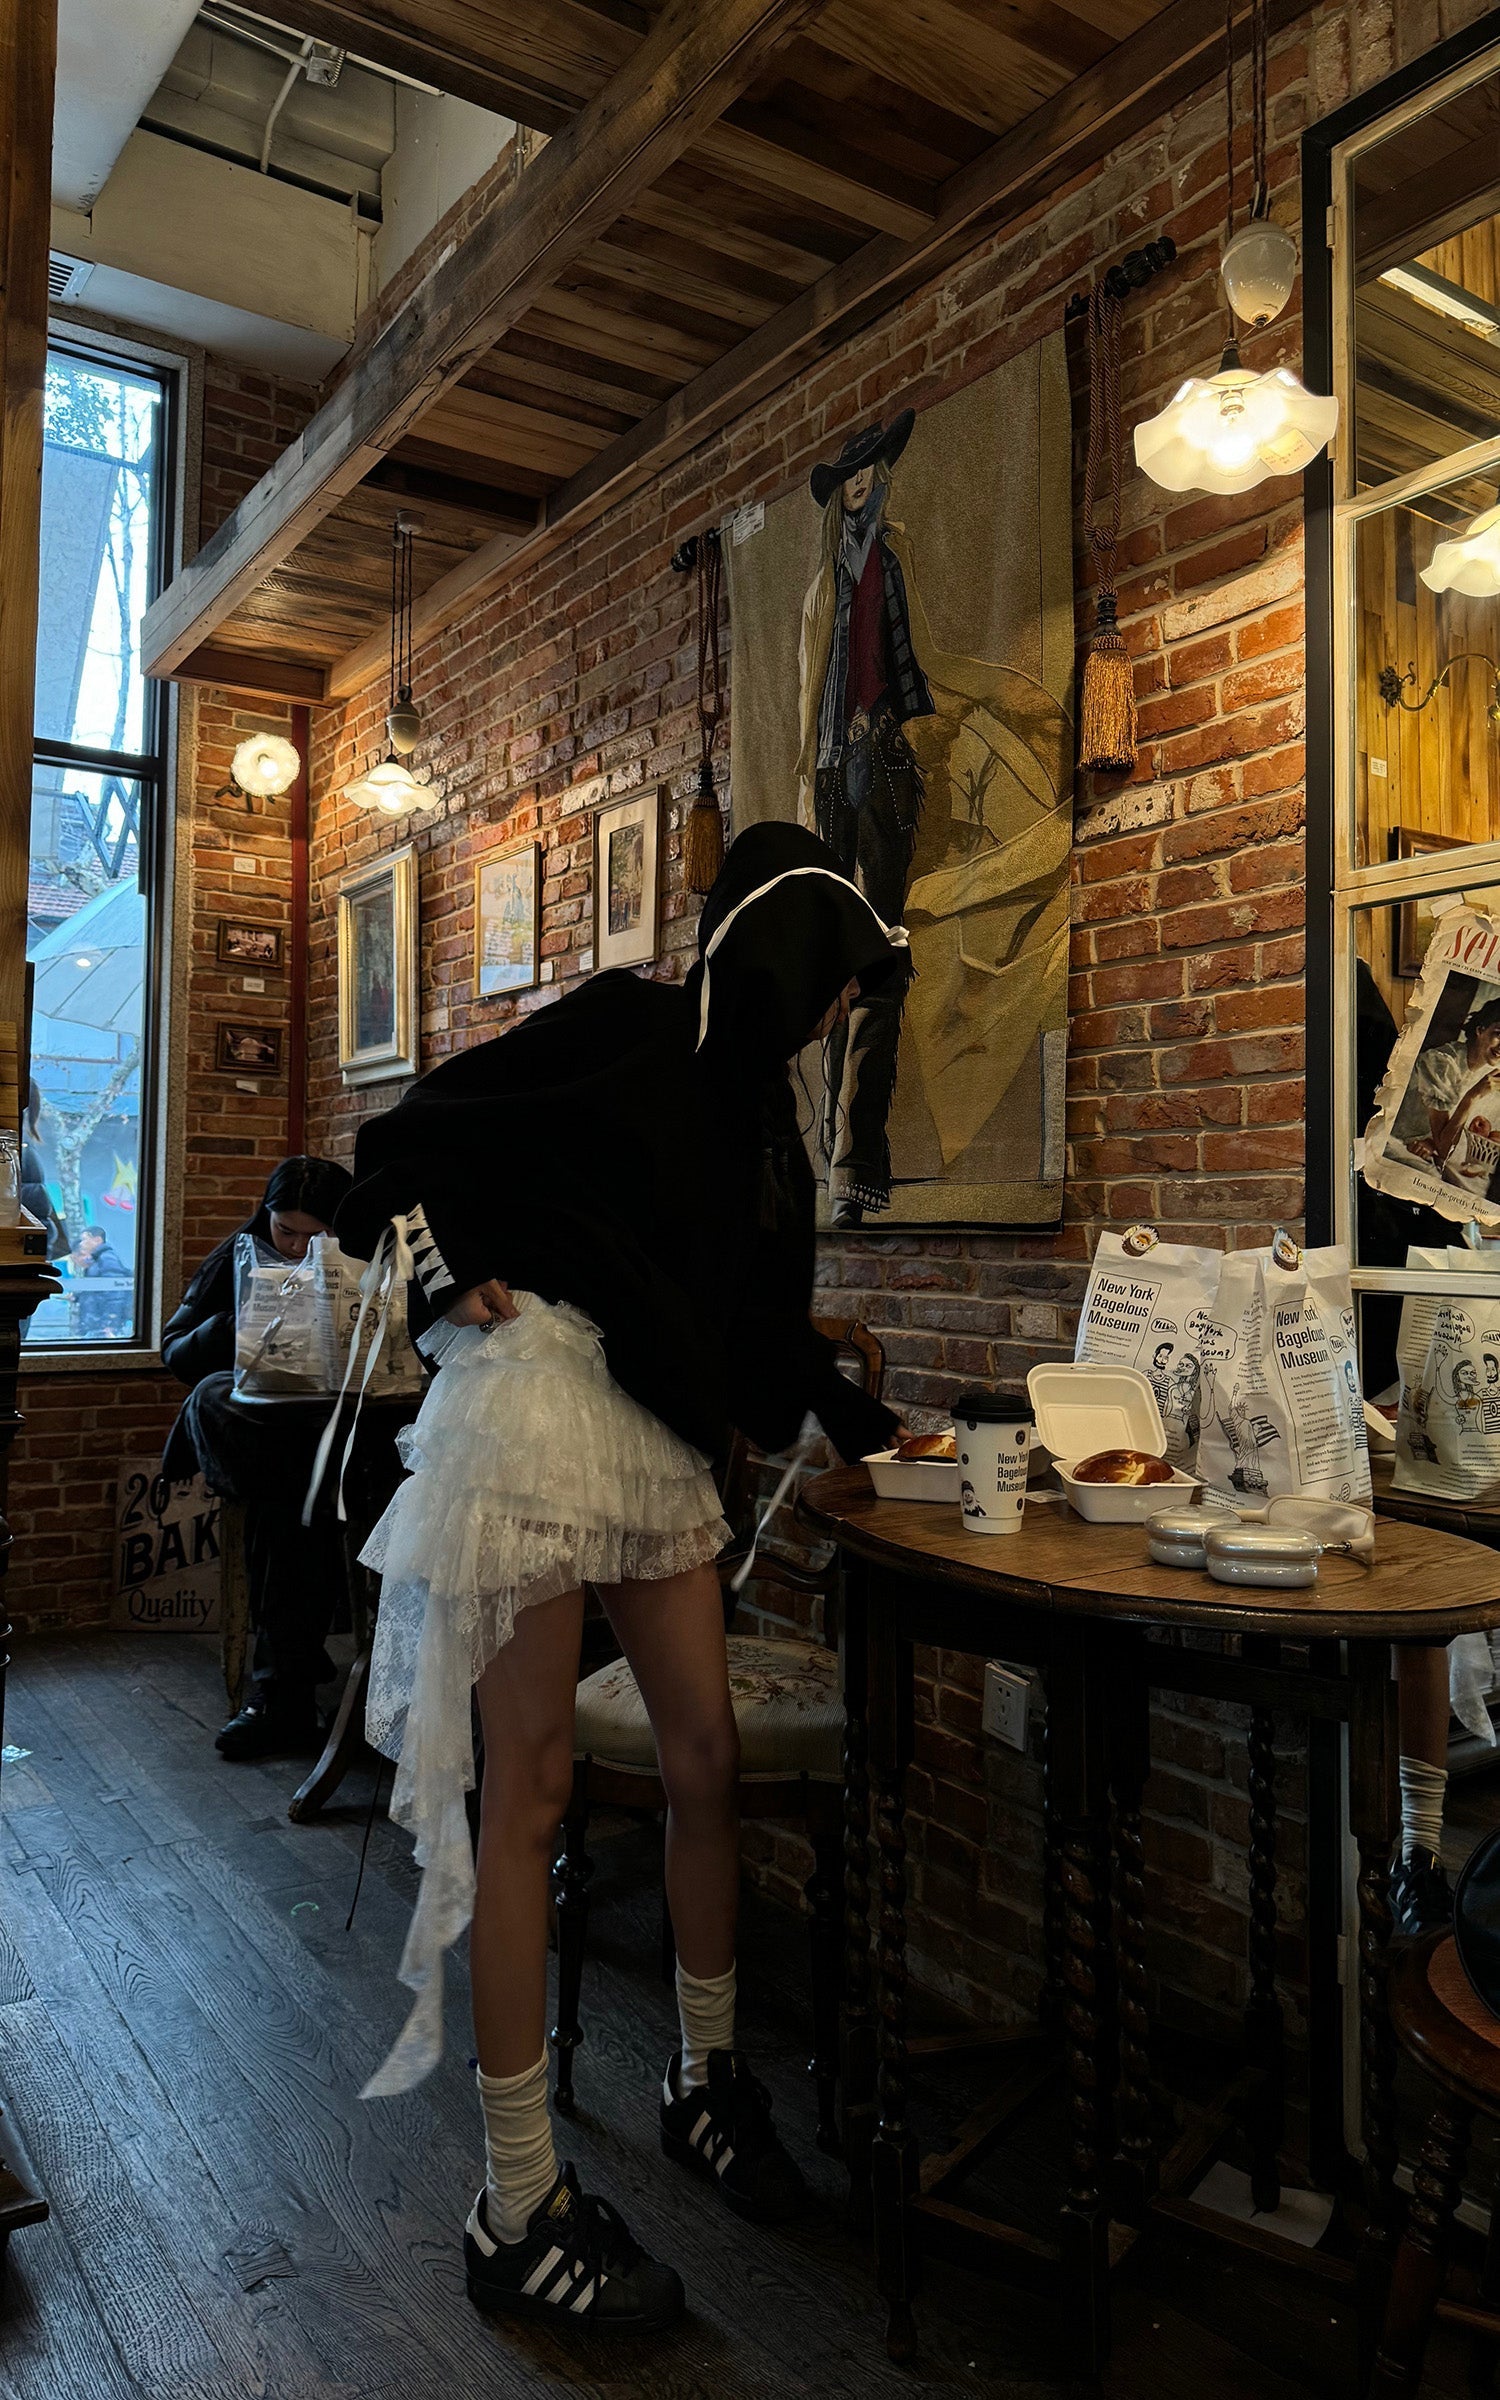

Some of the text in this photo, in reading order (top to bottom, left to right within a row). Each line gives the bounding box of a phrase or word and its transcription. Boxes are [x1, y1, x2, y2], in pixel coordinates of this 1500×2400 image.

[1444, 926, 1500, 973] sev
[1471, 1202, 1489, 1216] Issue
[1097, 1277, 1155, 1301] New York
[1092, 1293, 1150, 1318] Bagelous
[1197, 1311, 1208, 1320] Ne
[1276, 1305, 1318, 1327] New ork
[1087, 1310, 1140, 1333] Museum
[1277, 1326, 1325, 1348] Bagelous
[1280, 1350, 1329, 1369] Museum
[998, 1452, 1017, 1464] New
[129, 1590, 214, 1626] Quality
